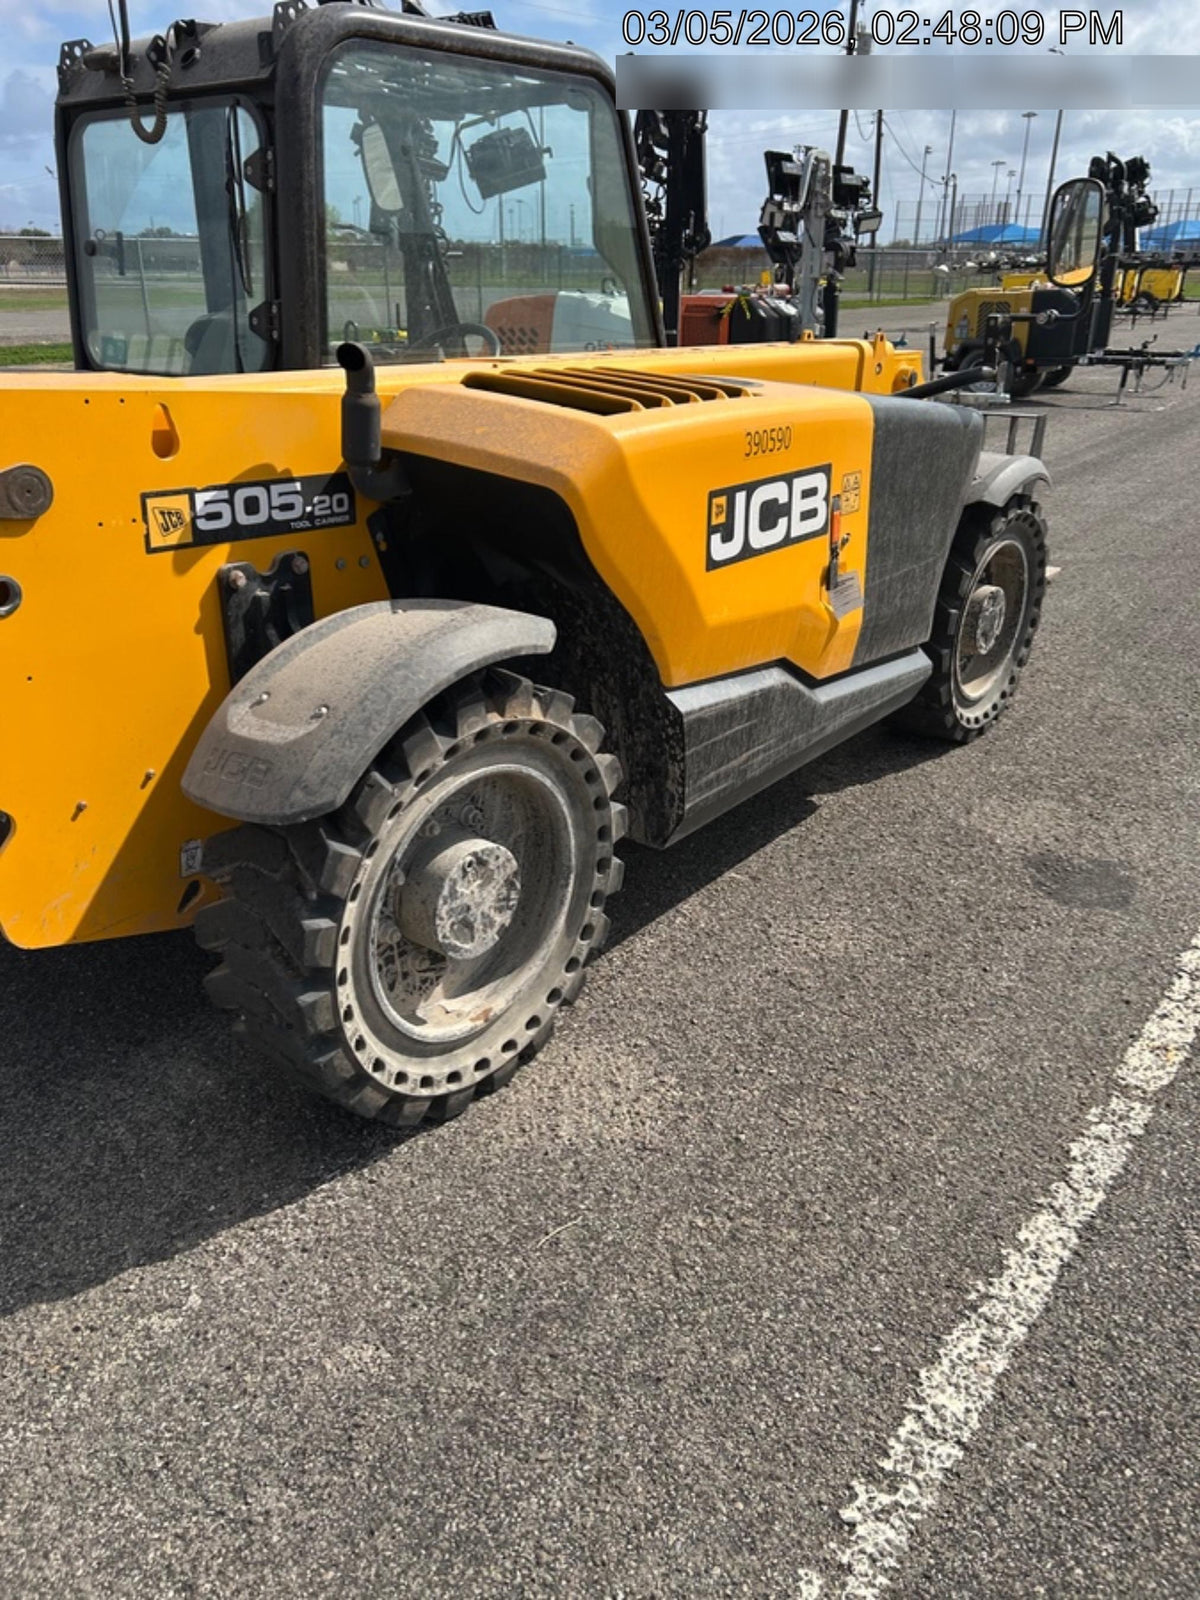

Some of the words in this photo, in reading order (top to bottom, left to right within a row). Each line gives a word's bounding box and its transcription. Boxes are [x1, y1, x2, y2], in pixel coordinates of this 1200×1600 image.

[744, 426, 792, 457] 390590
[158, 509, 185, 532] JCB
[290, 521, 312, 529] TOOL
[711, 472, 828, 561] JCB
[203, 748, 275, 790] JCB
